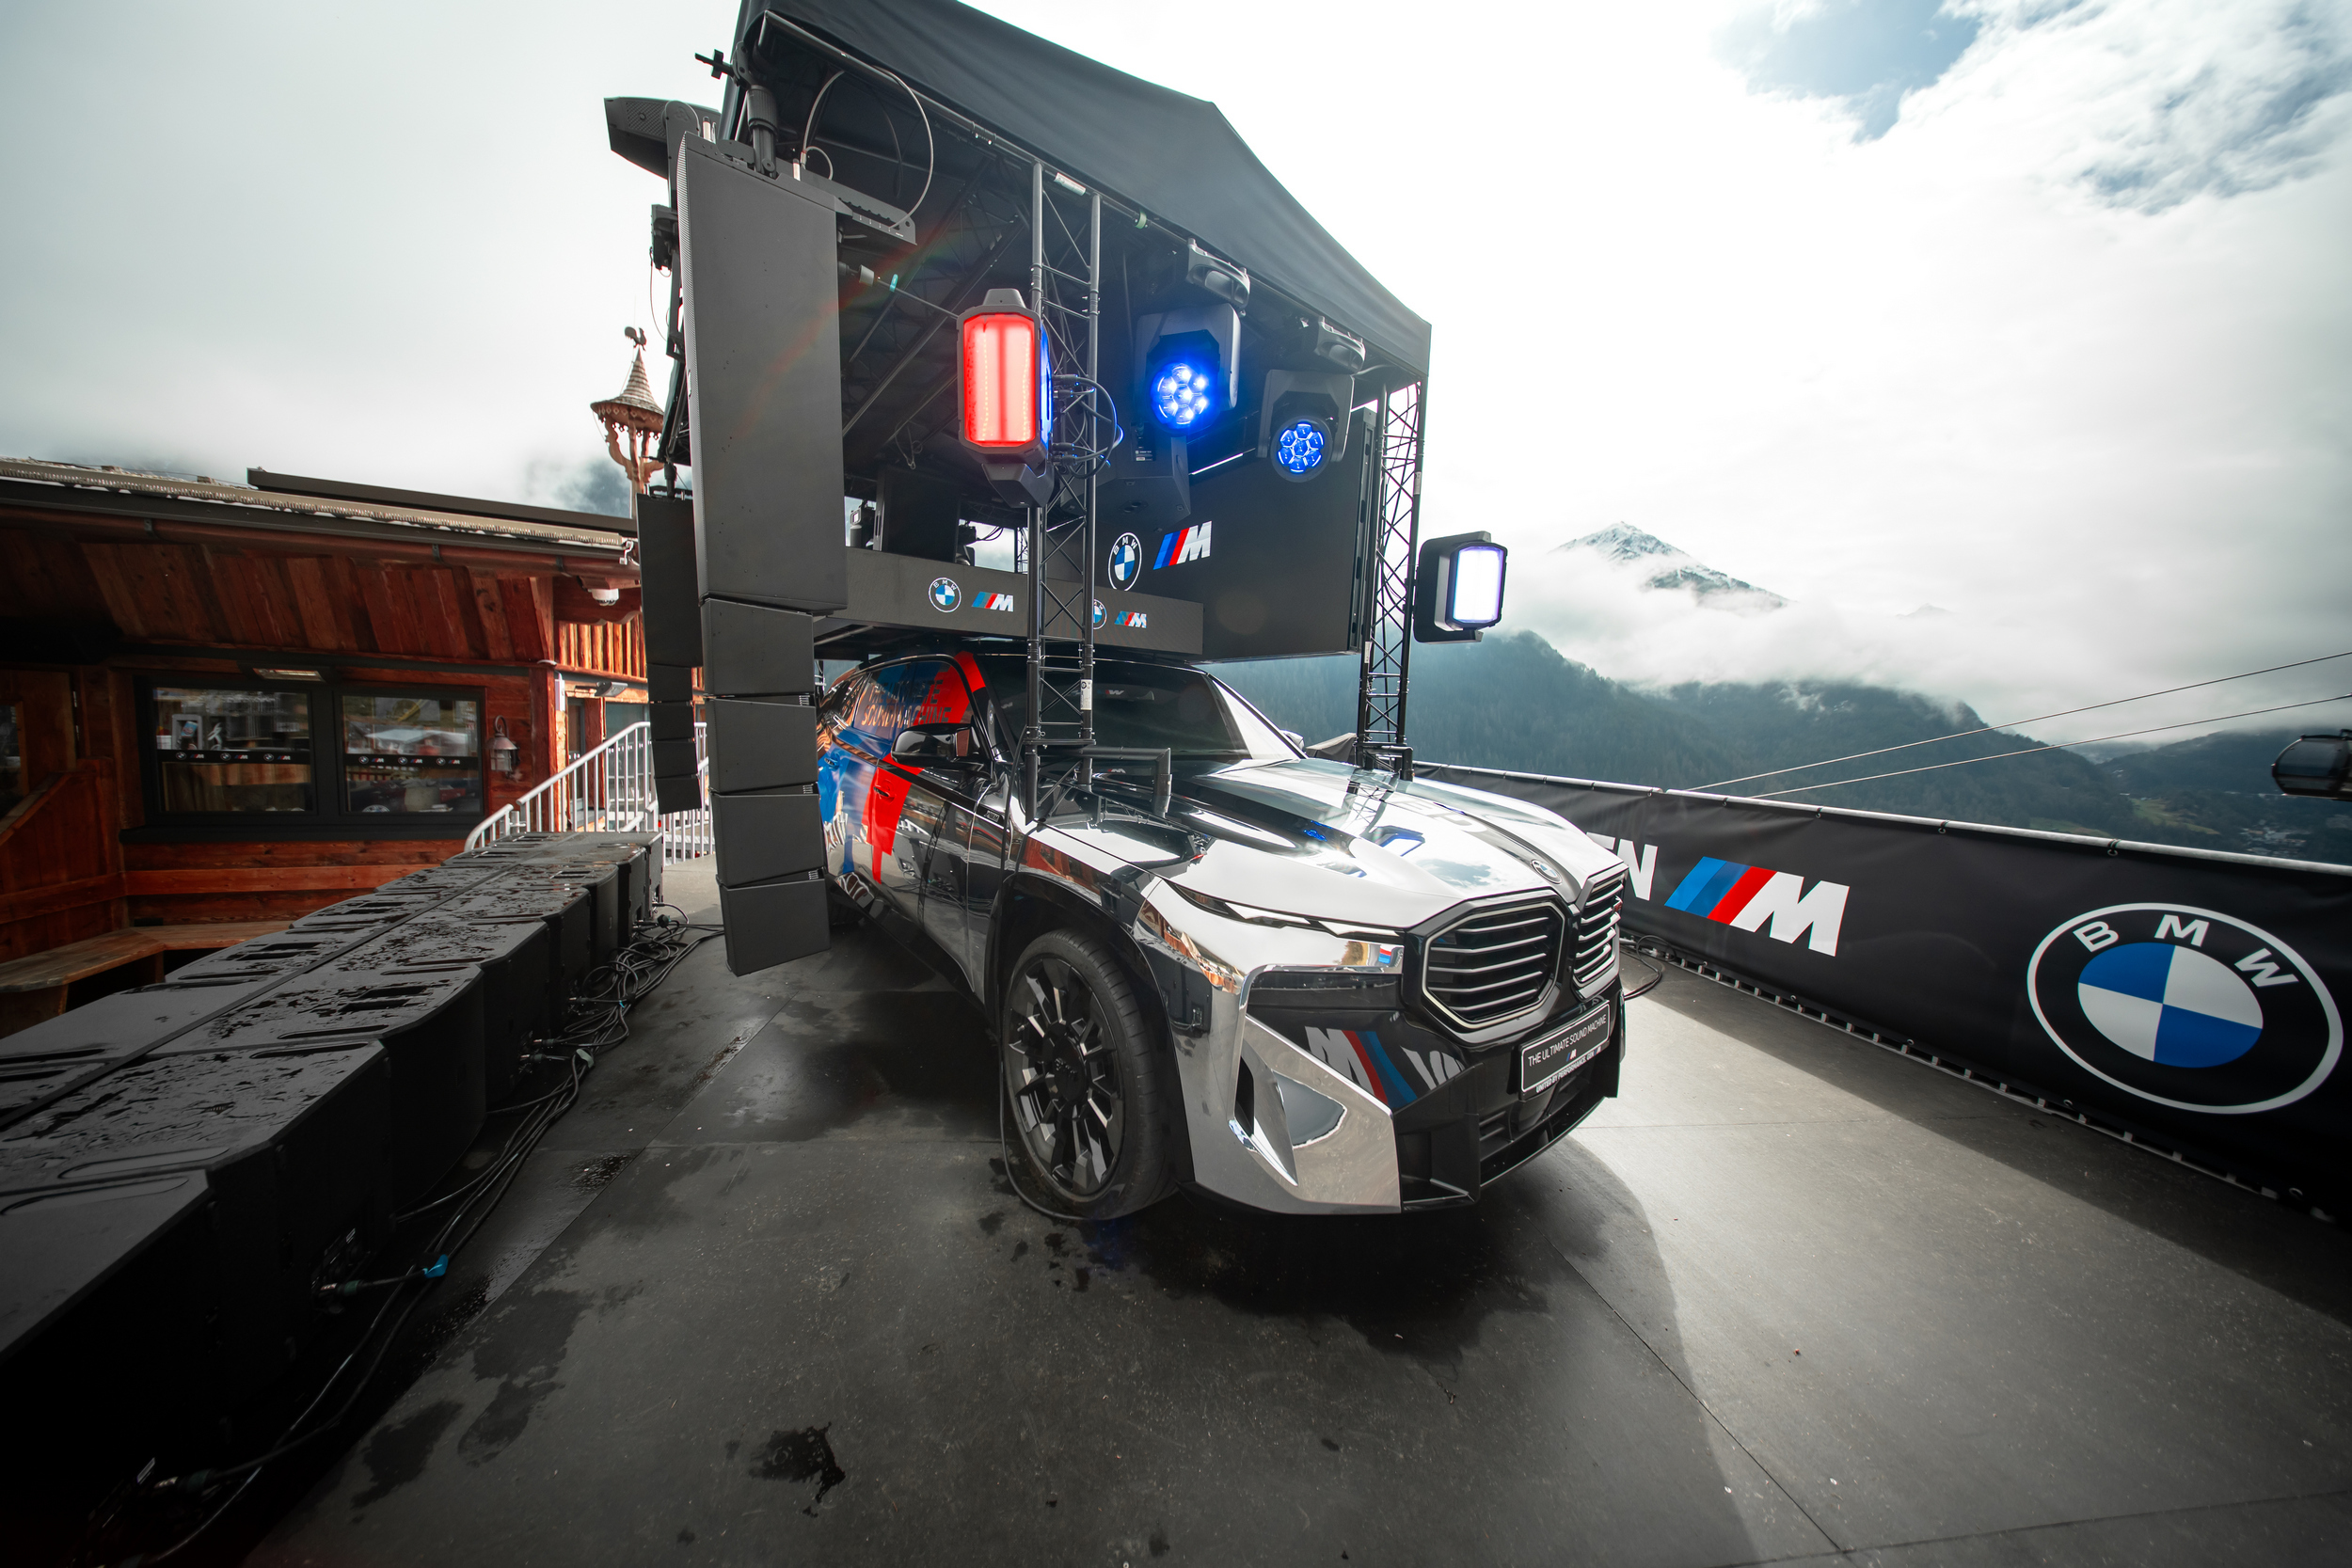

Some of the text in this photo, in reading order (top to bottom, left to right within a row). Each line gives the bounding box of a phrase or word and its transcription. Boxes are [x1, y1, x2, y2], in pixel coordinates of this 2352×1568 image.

[861, 704, 952, 728] SOUND MACHINE
[2073, 914, 2299, 989] BMW
[1528, 1014, 1607, 1067] THE ULTIMATE SOUND MACHINE
[1536, 1078, 1551, 1093] UNITED
[1551, 1074, 1559, 1084] BY
